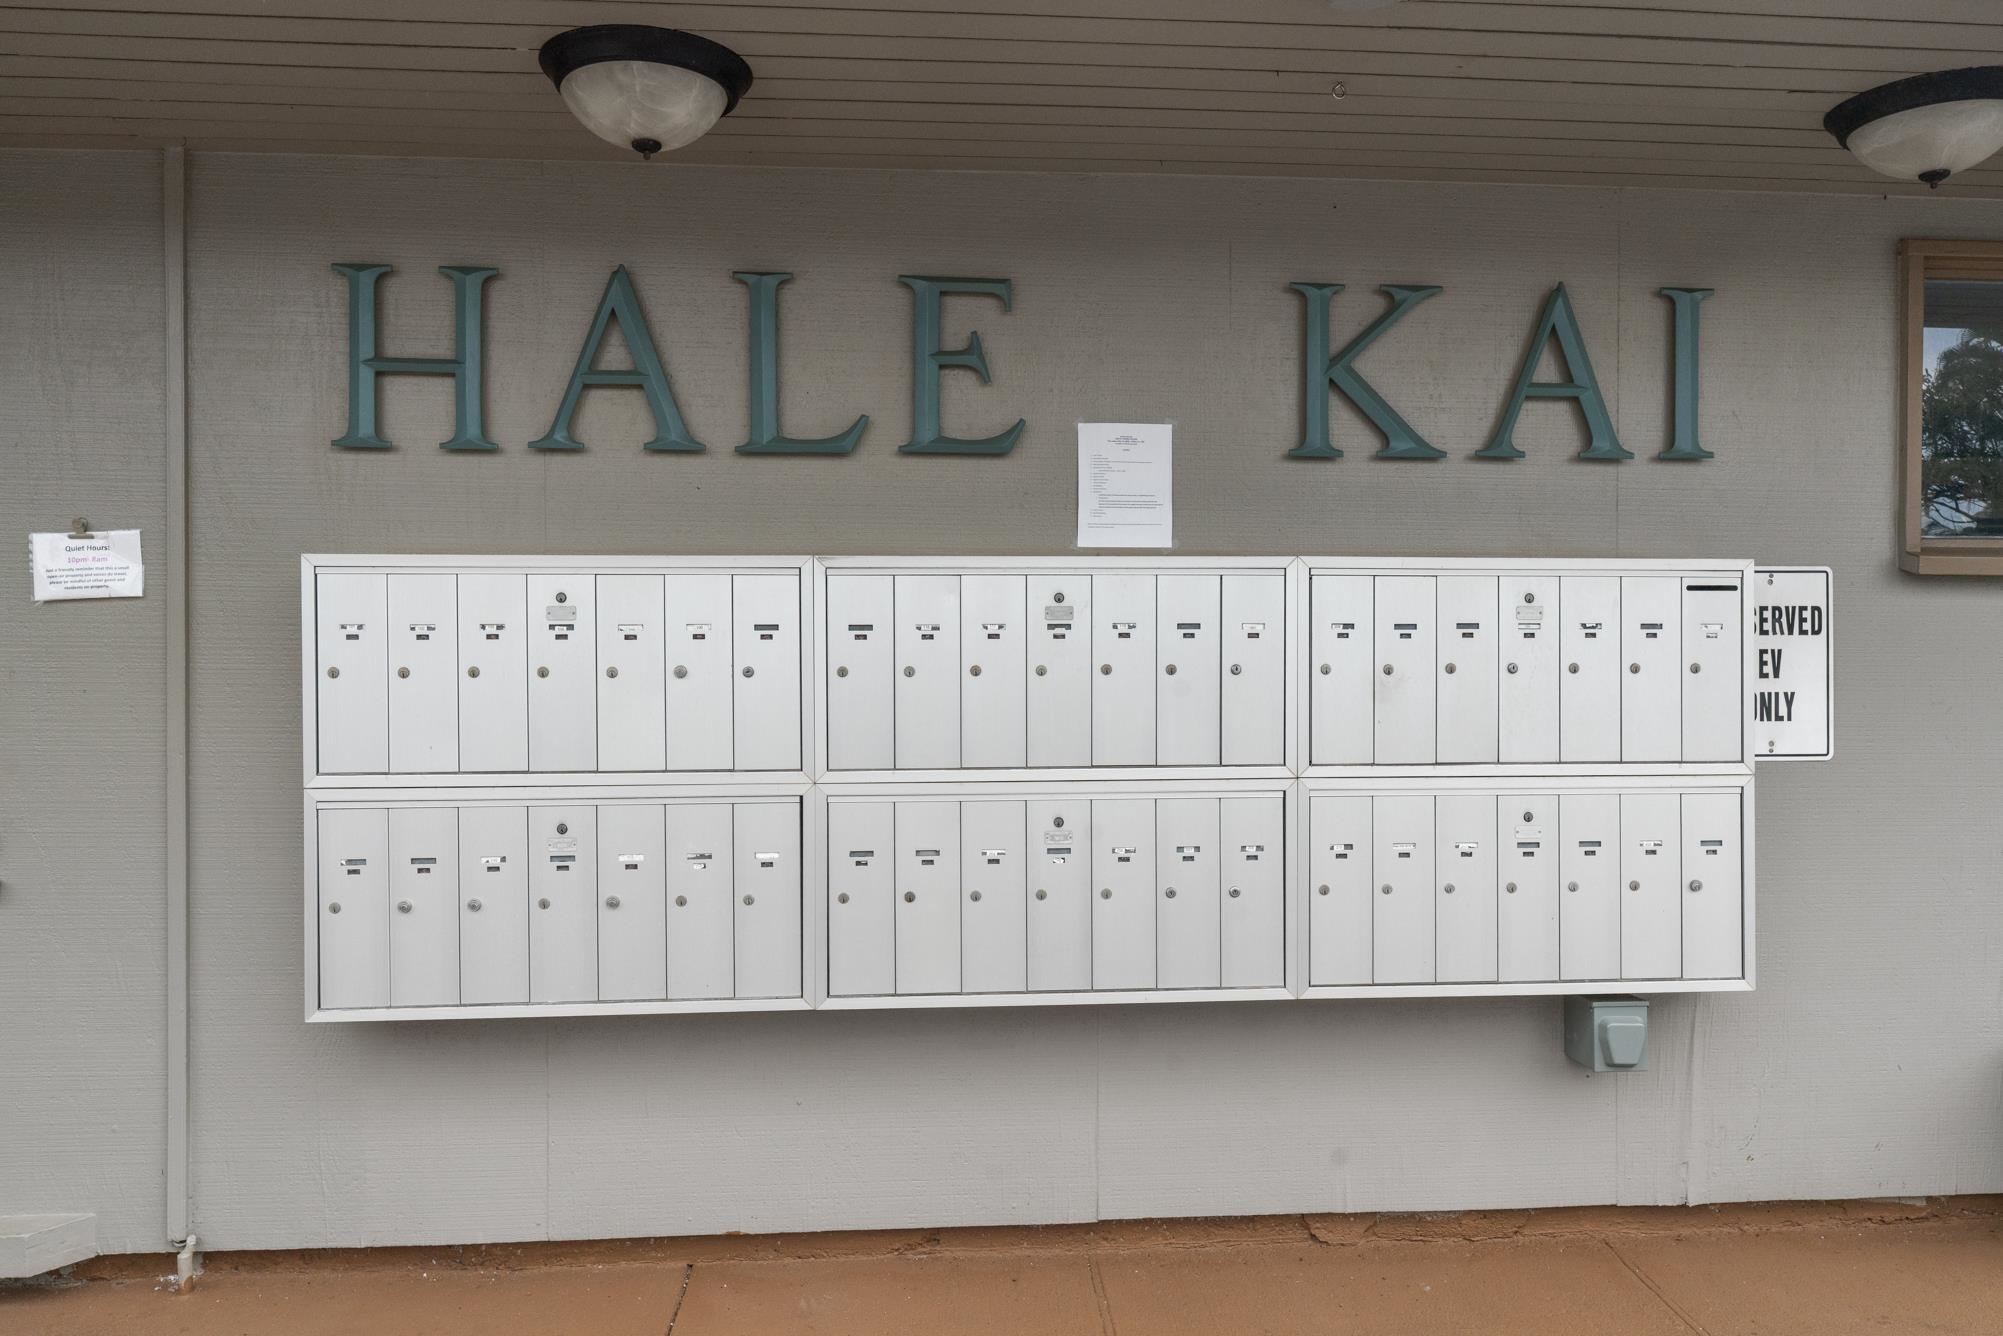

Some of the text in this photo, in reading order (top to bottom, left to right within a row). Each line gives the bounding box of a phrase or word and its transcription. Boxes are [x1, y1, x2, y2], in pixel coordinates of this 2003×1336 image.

[331, 262, 1715, 460] HALE KAI
[1754, 605, 1823, 636] ERVED
[1758, 648, 1782, 679] EV
[1754, 691, 1796, 722] NLY
